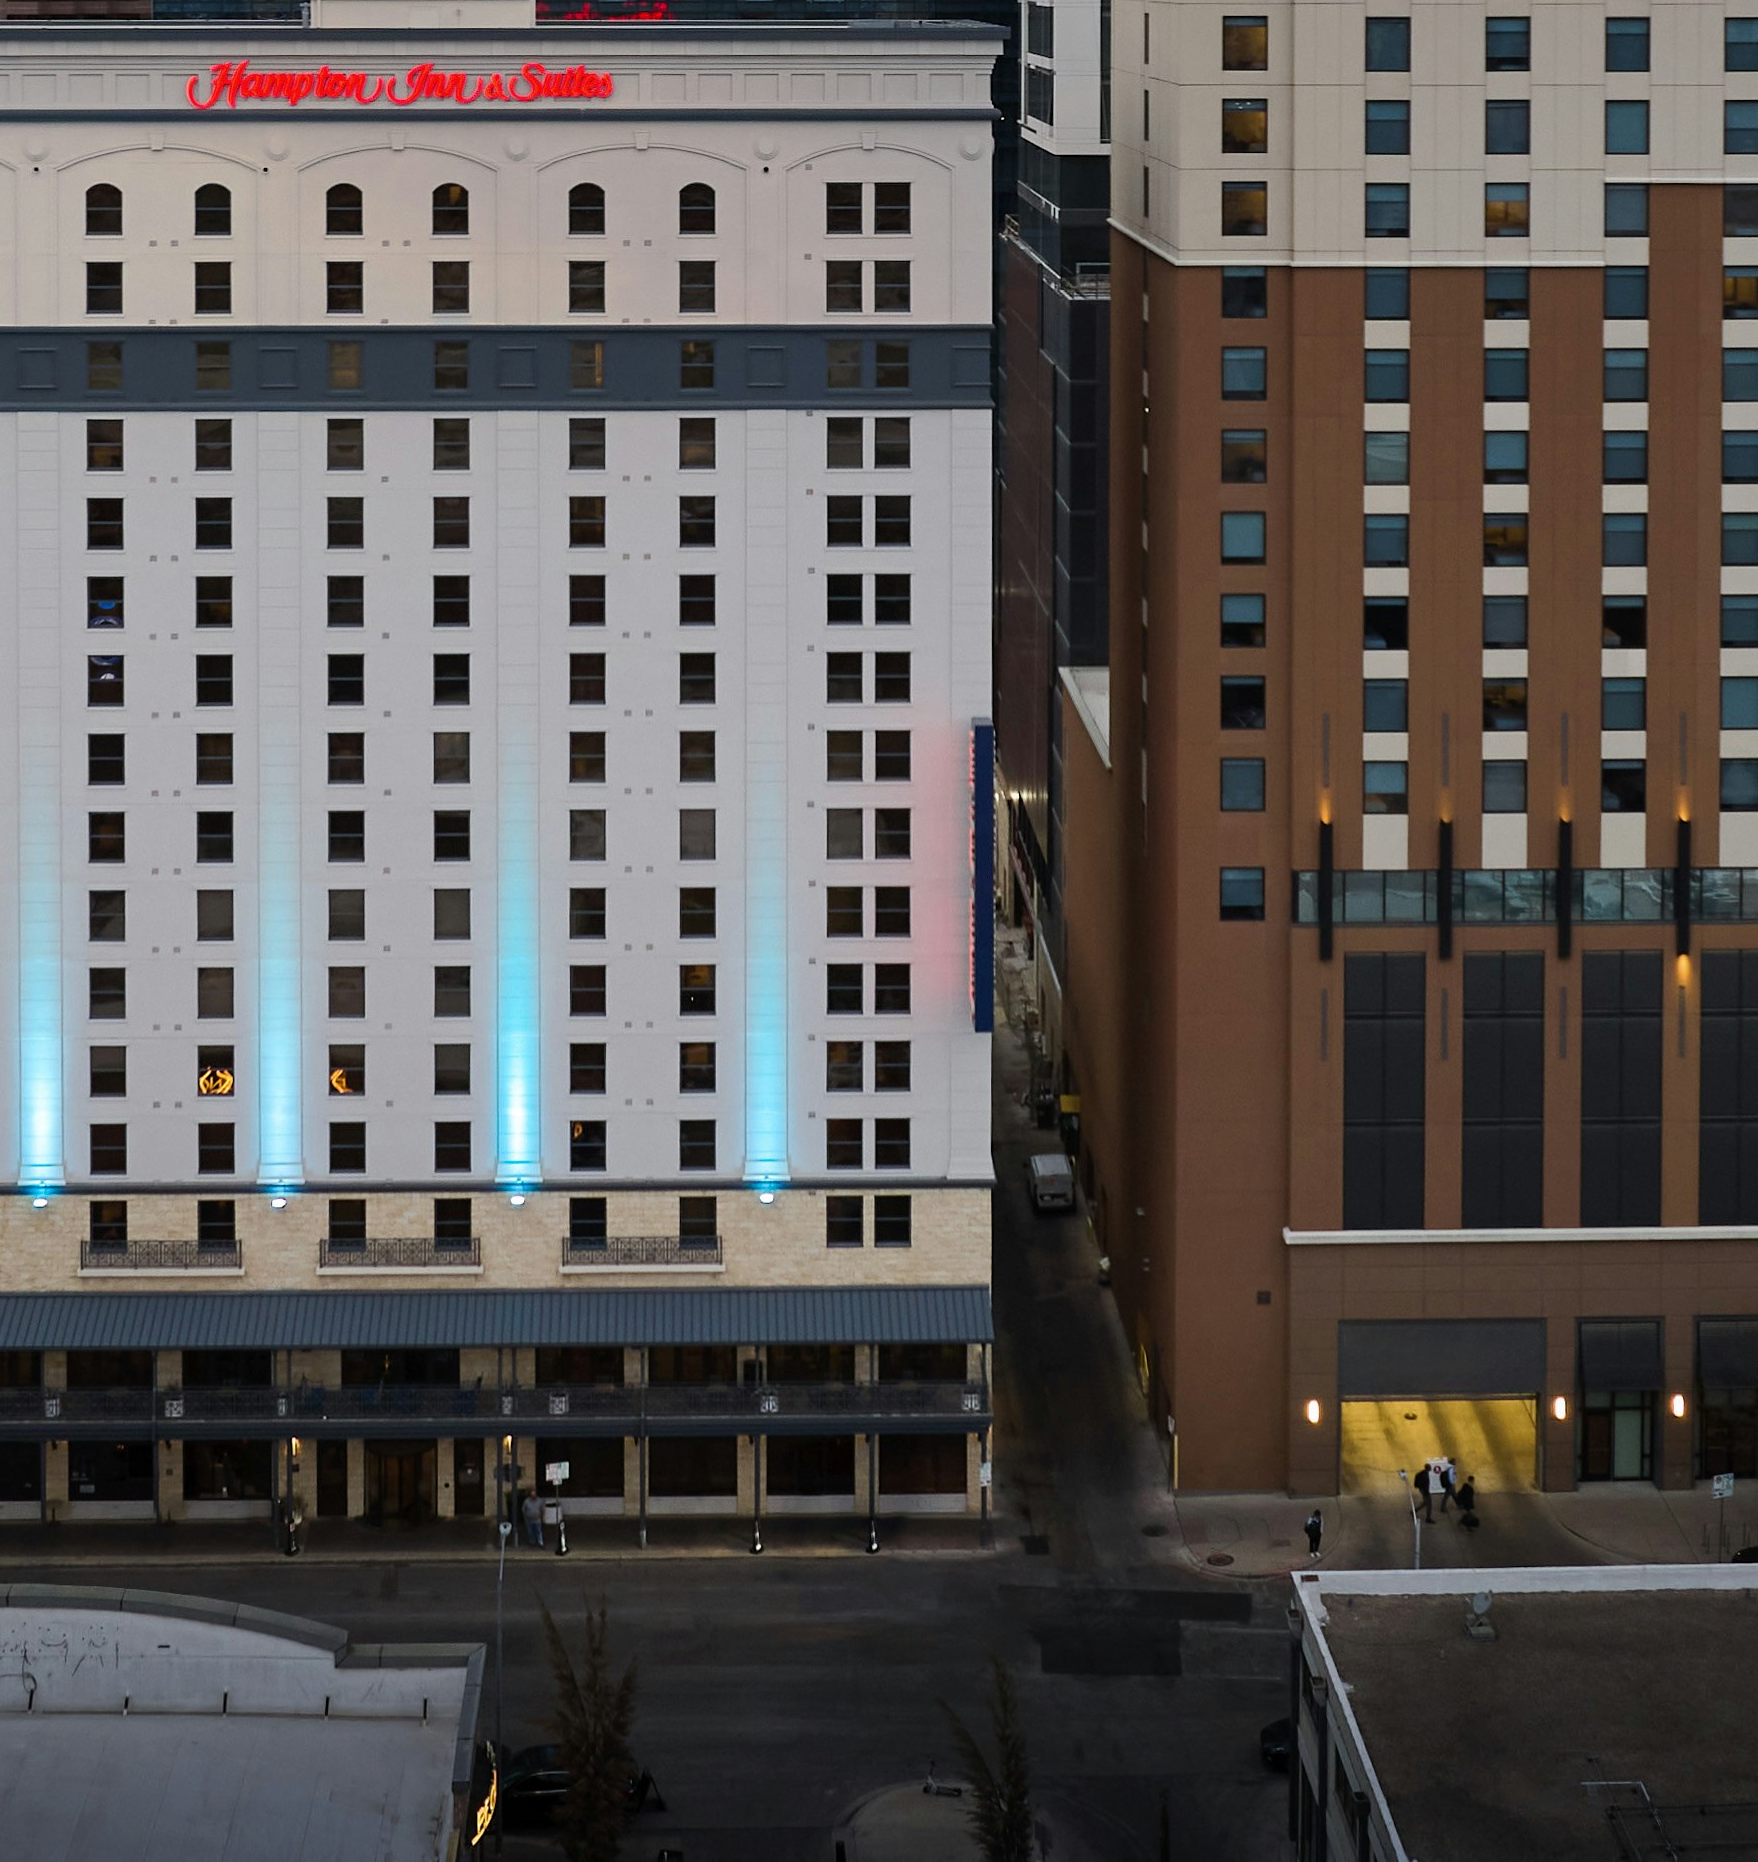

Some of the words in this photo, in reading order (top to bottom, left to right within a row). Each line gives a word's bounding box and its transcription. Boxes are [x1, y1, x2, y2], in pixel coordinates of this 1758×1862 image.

[186, 60, 383, 110] Hampton
[386, 62, 484, 106] Inn
[484, 73, 510, 102] &
[509, 61, 614, 103] Suites
